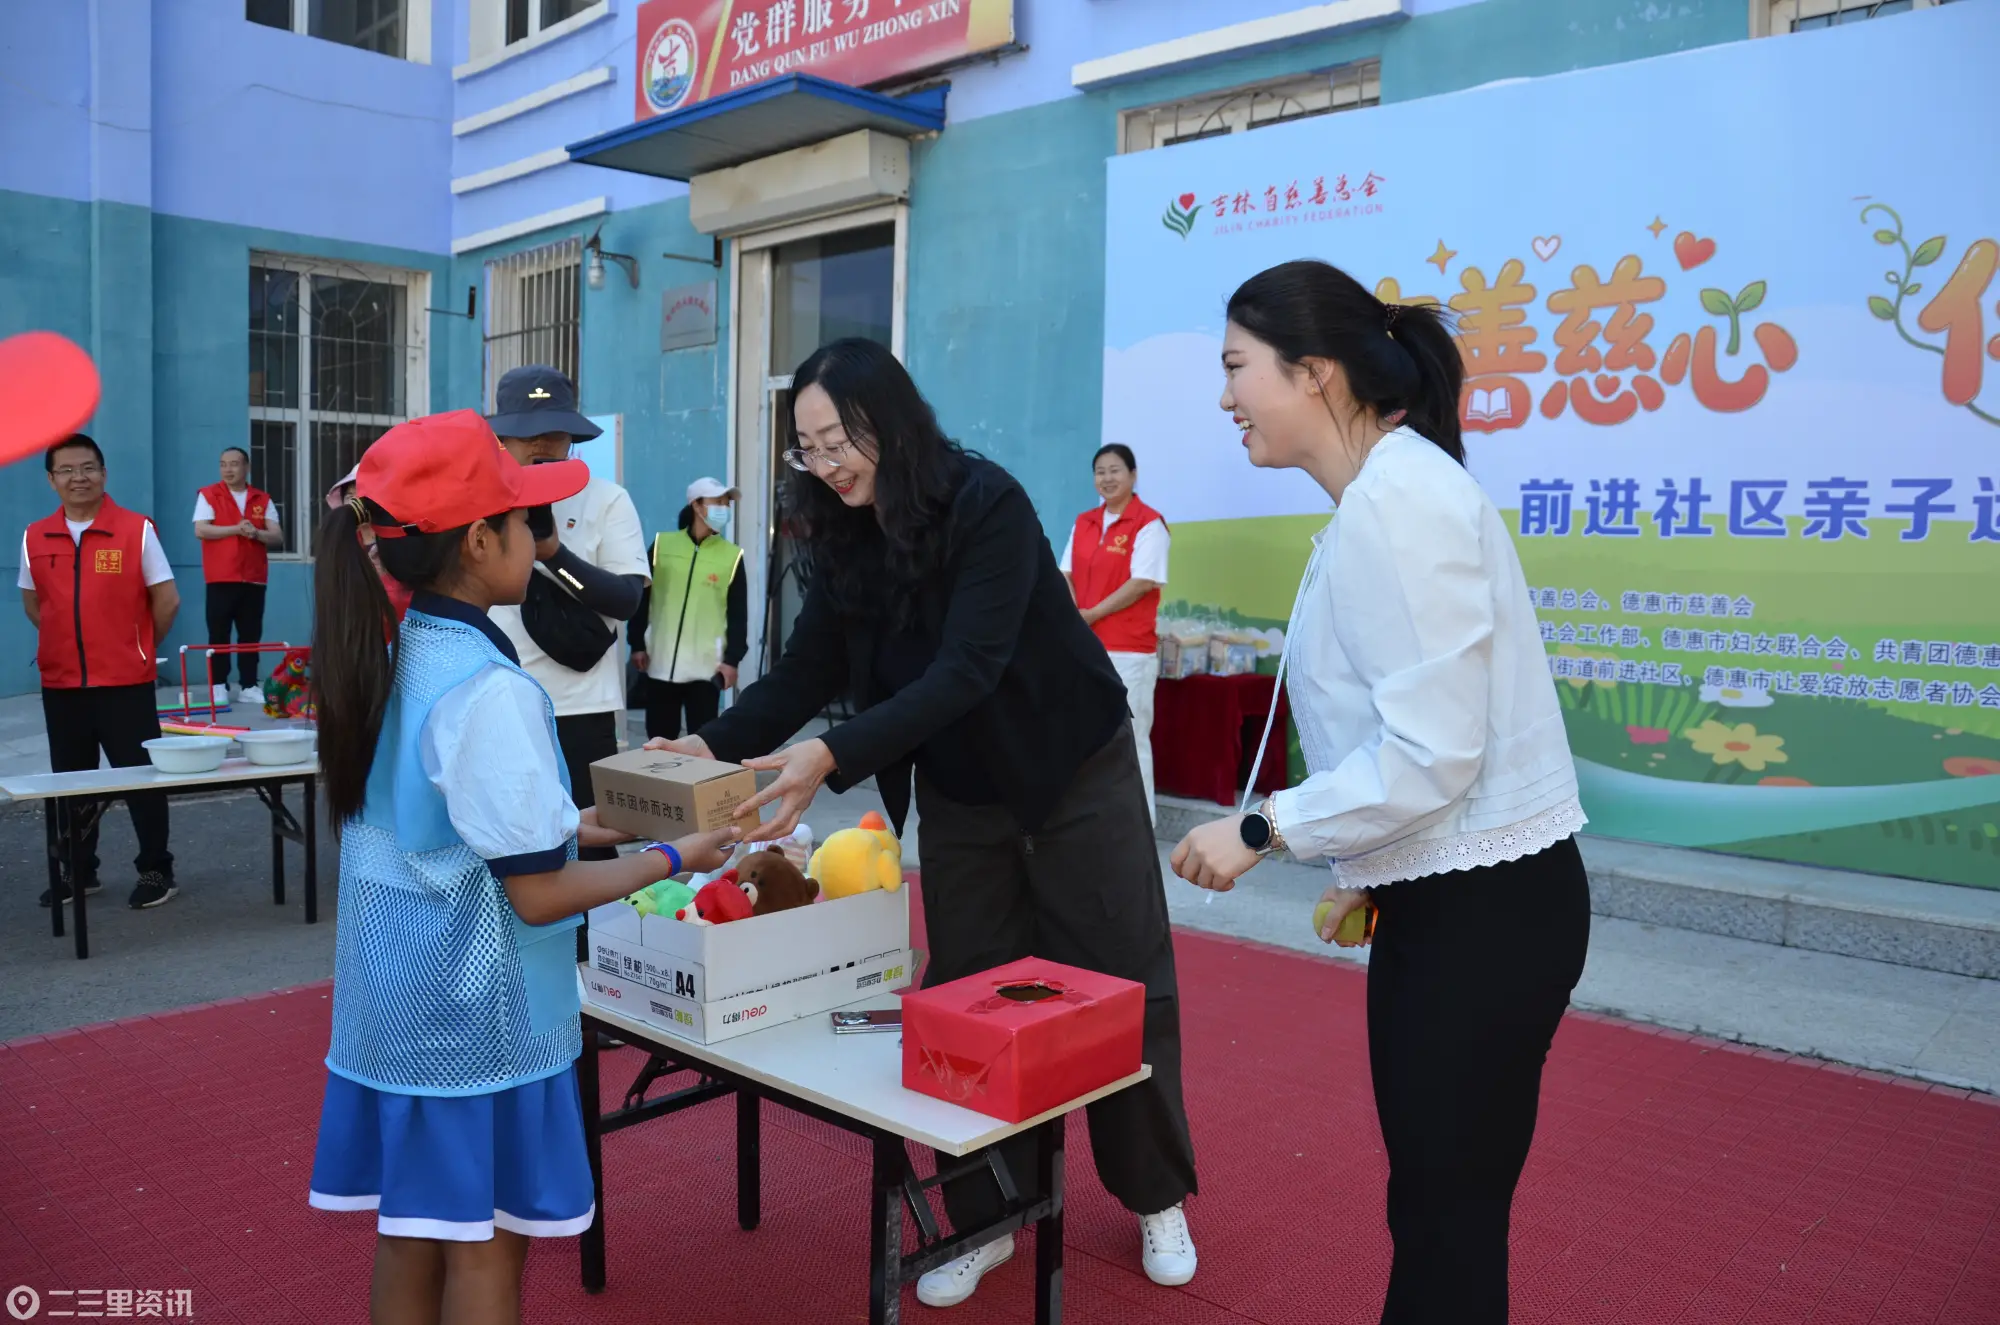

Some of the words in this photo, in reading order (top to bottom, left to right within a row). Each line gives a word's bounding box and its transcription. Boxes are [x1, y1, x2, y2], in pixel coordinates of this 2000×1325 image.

[729, 59, 770, 87] DANG
[773, 48, 805, 74] QUN
[809, 38, 830, 62] FU
[834, 29, 860, 53] WU
[862, 10, 923, 45] ZHONG
[927, 0, 961, 23] XIN
[1210, 170, 1386, 218] 吉林省慈善总会
[1213, 223, 1243, 236] JILIN
[1247, 214, 1299, 231] CHARITY
[1303, 203, 1384, 223] FEDERATION
[1375, 254, 1798, 434] 善慈心
[1548, 656, 2000, 707] 街道前进社区、德惠市让爱绽放志愿者协会
[604, 789, 685, 823] 音乐因你而改变
[675, 970, 695, 999] A4
[722, 1004, 768, 1025] deli得力
